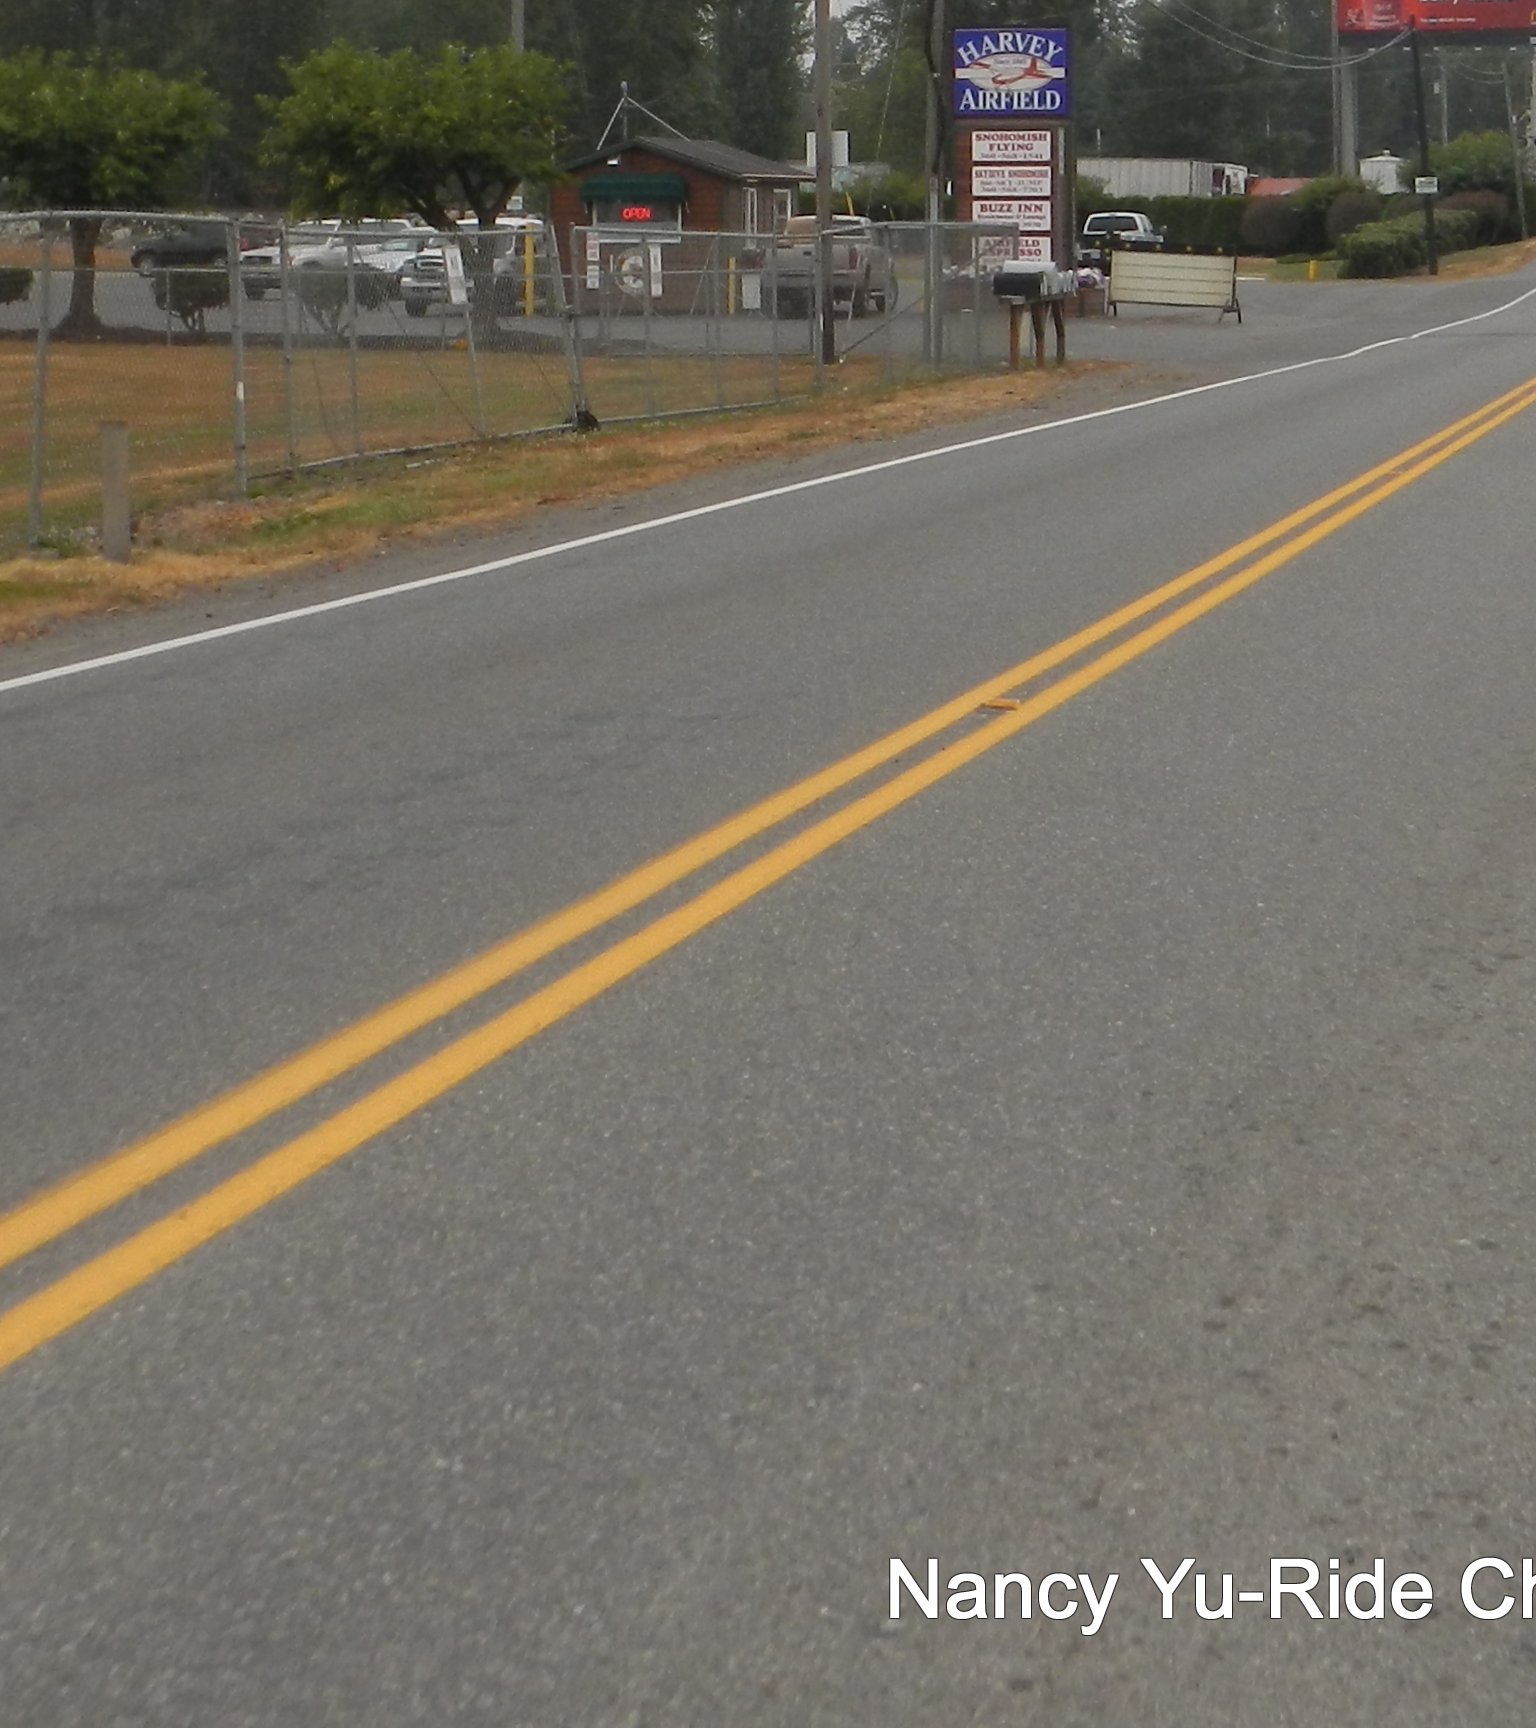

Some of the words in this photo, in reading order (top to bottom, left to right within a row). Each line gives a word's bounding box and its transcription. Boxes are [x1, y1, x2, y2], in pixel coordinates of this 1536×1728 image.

[957, 32, 1063, 66] HARVEY
[959, 88, 1061, 110] AIRFIELD
[975, 133, 1047, 142] SNOHOMISH
[989, 143, 1034, 151] FLYING
[623, 207, 651, 219] OPEN
[979, 203, 1013, 213] BUZZ
[1018, 203, 1043, 213] INN
